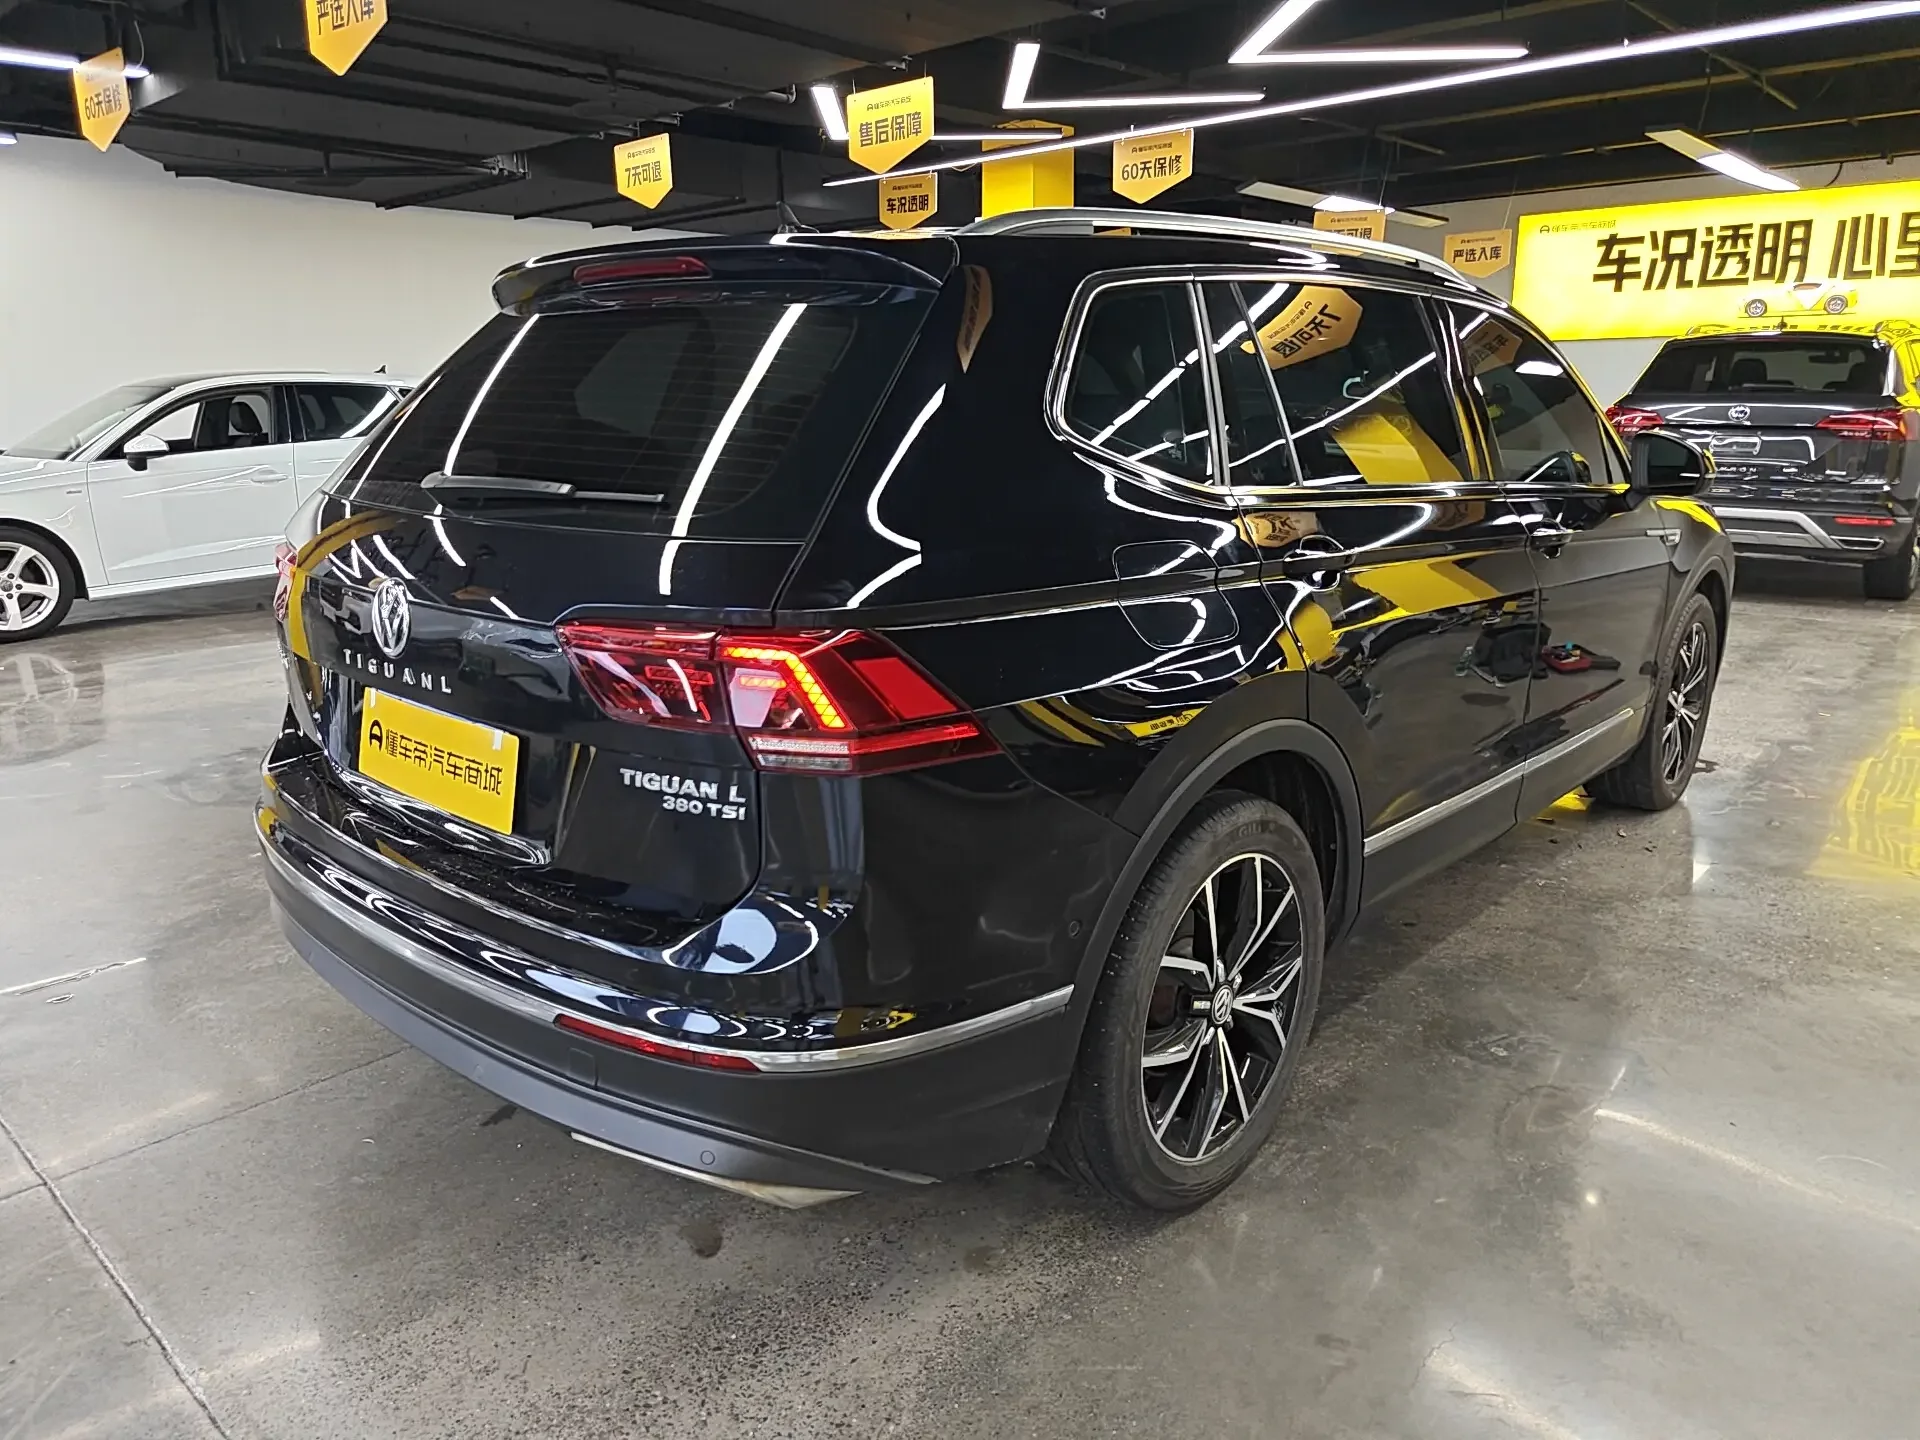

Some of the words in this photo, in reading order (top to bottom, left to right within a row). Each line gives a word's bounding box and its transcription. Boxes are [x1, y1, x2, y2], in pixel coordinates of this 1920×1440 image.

[84, 84, 123, 120] 60天保修
[859, 111, 922, 147] 售后保障
[624, 160, 662, 188] 7天可退
[1121, 154, 1183, 181] 60天保修
[886, 194, 930, 215] 车况透明
[1452, 245, 1502, 263] 严选入库
[1593, 218, 1813, 292] 车况透明
[385, 728, 503, 796] 懂车帝汽车商城
[619, 767, 719, 800] TIGUAN
[728, 784, 747, 803] L
[662, 795, 703, 815] 380
[706, 802, 747, 821] TSI
